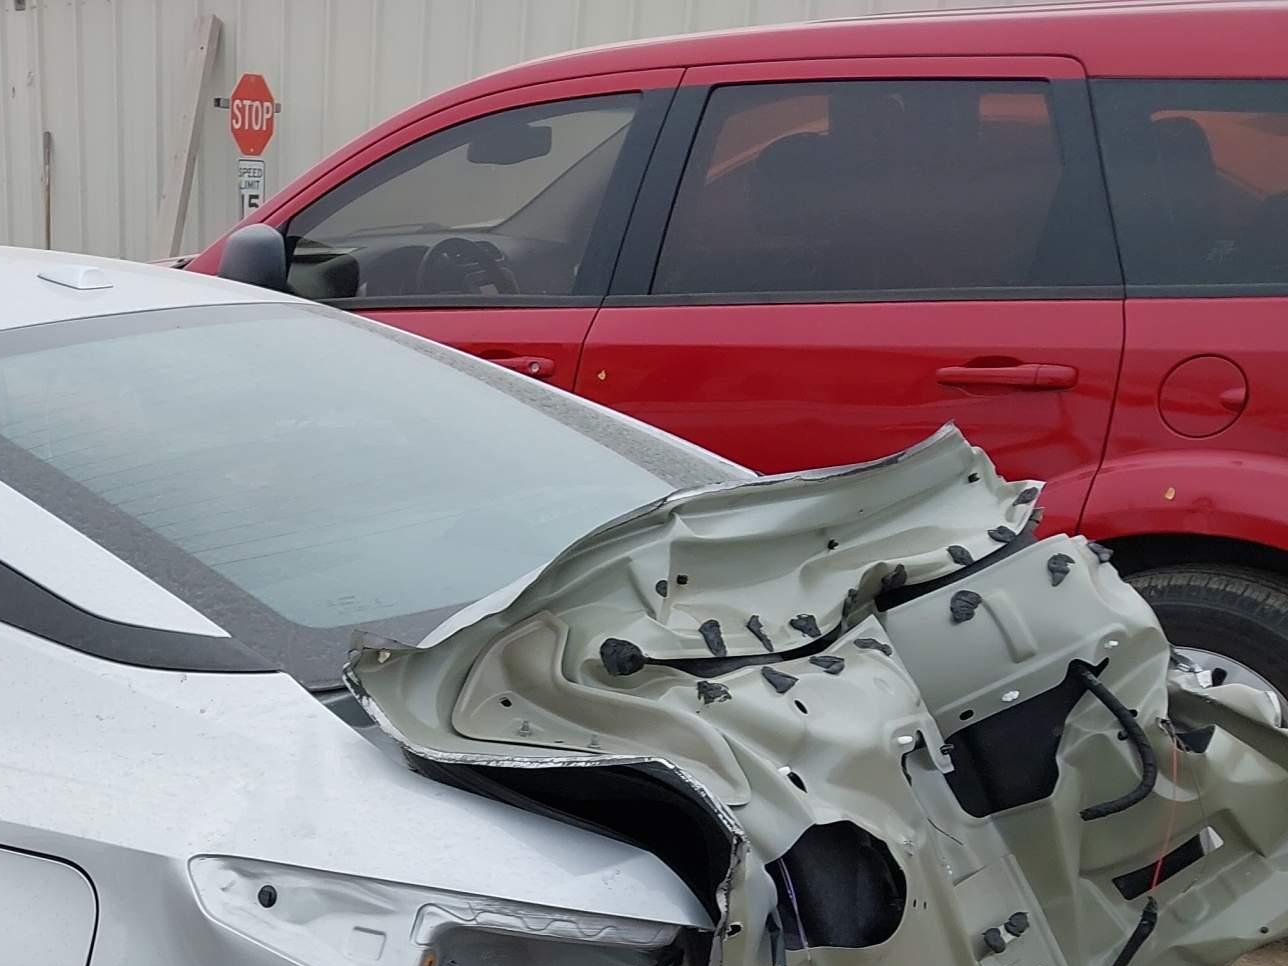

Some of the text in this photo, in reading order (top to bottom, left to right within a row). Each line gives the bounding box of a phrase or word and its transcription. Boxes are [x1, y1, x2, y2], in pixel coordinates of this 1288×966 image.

[232, 99, 272, 130] STOP
[239, 167, 263, 178] SPEED
[239, 180, 260, 190] LIMIT
